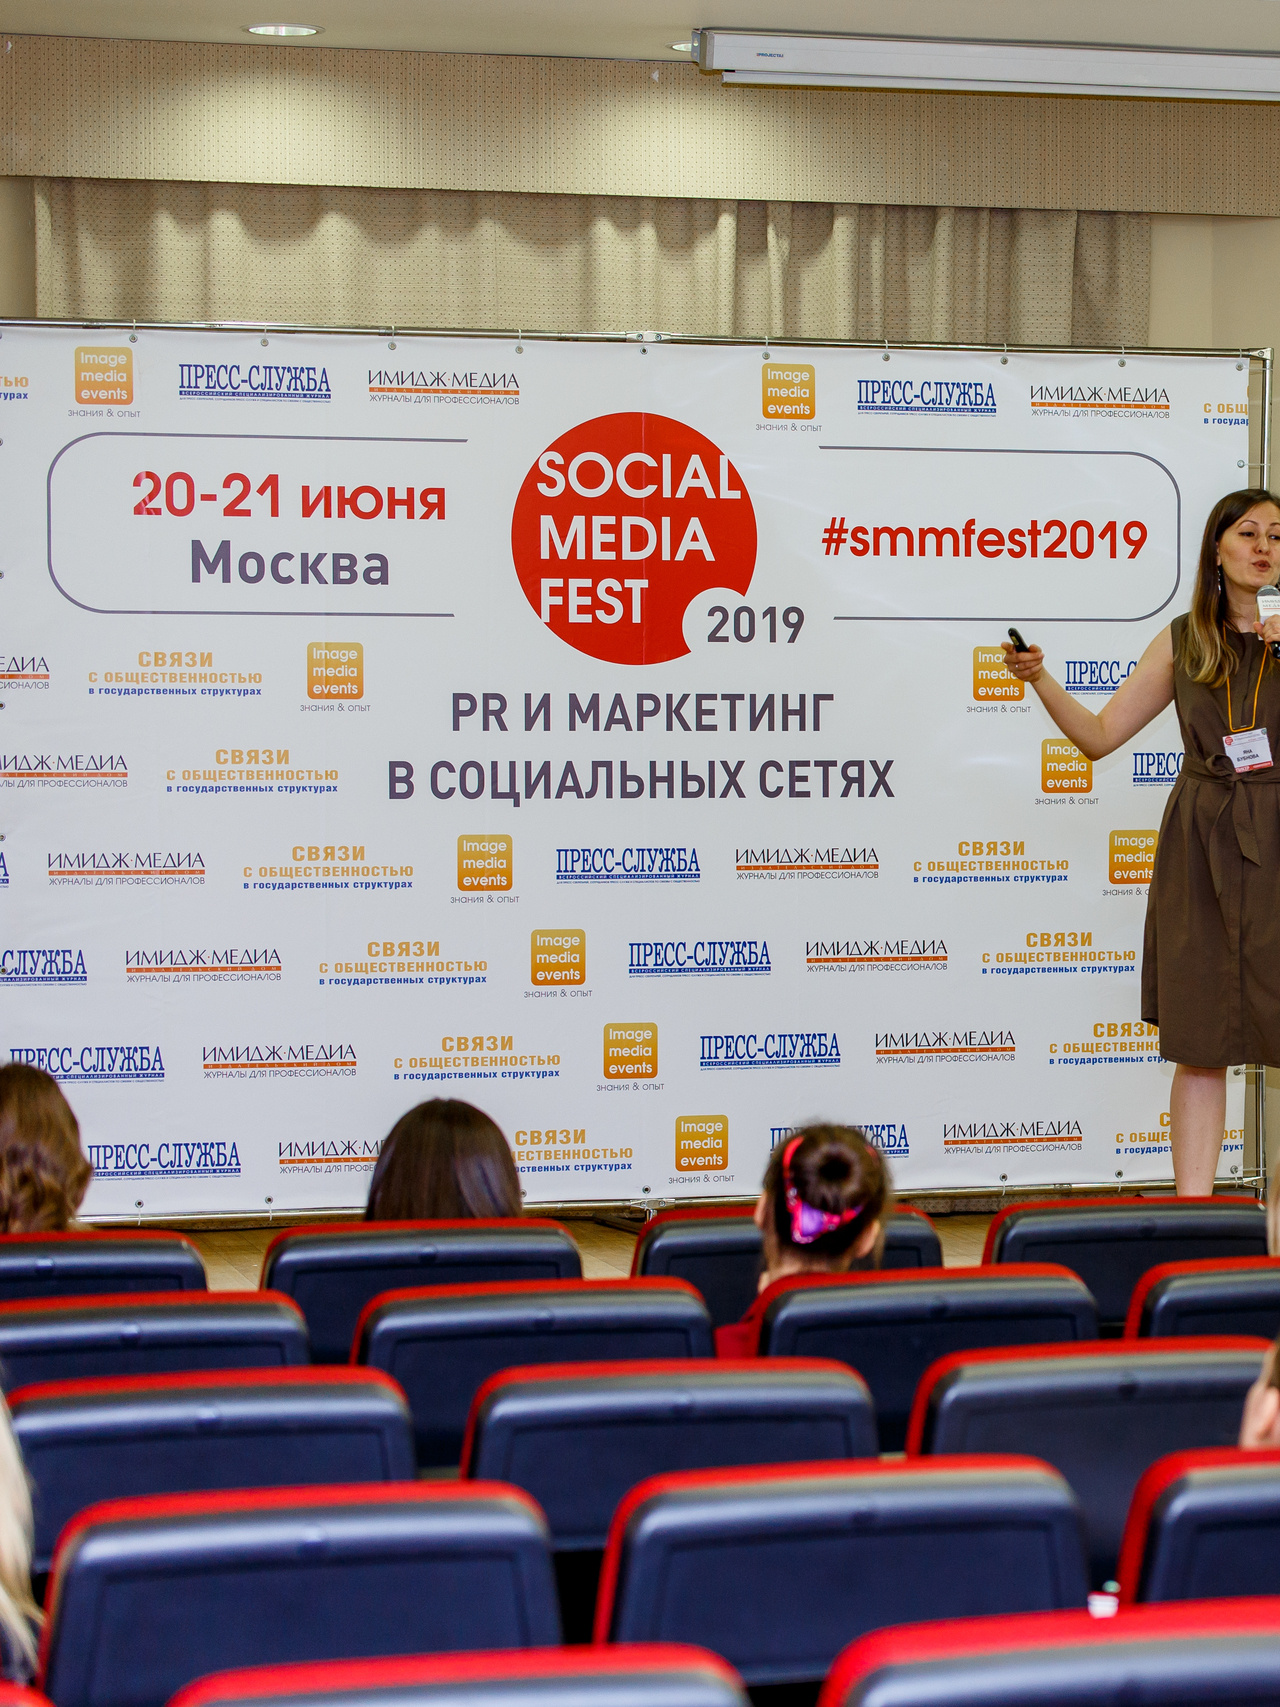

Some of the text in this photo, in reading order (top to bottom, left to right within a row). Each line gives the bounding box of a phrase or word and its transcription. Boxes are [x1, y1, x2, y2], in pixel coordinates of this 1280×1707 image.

[80, 352, 128, 367] Image
[80, 370, 127, 382] media
[179, 364, 331, 392] ПРЕСС-СЛУЖБА
[767, 369, 810, 384] Image
[81, 387, 128, 400] events
[767, 385, 809, 398] media
[858, 378, 996, 407] ПРЕСС-СЛУЖБА
[370, 395, 412, 403] ЖУРНАЛЫ
[434, 397, 519, 405] ПРОФЕССИОНАЛОВ
[68, 408, 141, 418] знания & опыт
[767, 402, 810, 416] events
[1031, 409, 1170, 418] ЖУРНАЛЫ ДЛЯ ПРОФЕССИОНАЛОВ
[755, 423, 822, 433] знания & опыт
[537, 451, 742, 499] SOCIAL
[133, 471, 445, 520] 20-21 июня
[540, 514, 716, 562] MEDIA
[822, 517, 1147, 559] #smmfest2019
[192, 540, 388, 585] Москва
[540, 577, 649, 624] FEST
[708, 606, 804, 643] 2019
[139, 652, 212, 667] СВЯЗИ
[313, 647, 357, 662] Image
[89, 672, 262, 684] С ОБЩЕСТВЕННОСТЬЮ
[313, 665, 356, 678] media
[99, 688, 196, 696] государственных
[313, 682, 358, 695] events
[348, 704, 370, 712] опыт
[453, 693, 834, 732] PR И МАРКЕТИНГ
[216, 749, 289, 765] СВЯЗИ
[167, 770, 338, 782] С ОБЩЕСТВЕННОСТЬЮ
[389, 760, 895, 807] В СОЦИАЛЬНЫХ СЕТЯХ
[292, 846, 364, 861] СВЯЗИ
[464, 840, 506, 855] Image
[959, 841, 1024, 856] СВЯЗИ
[463, 857, 506, 869] media
[556, 848, 700, 873] ПРЕСС-СЛУЖБА
[914, 860, 1068, 873] С ОБЩЕСТВЕННОСТЬЮ
[244, 866, 413, 879] С ОБЩЕСТВЕННОСТЬЮ
[736, 870, 879, 880] ЖУРНАЛЫ ДЛЯ ПРОФЕССИОНАЛОВ
[48, 876, 206, 886] ЖУРНАЛЫ ДЛЯ ПРОФЕССИОНАЛОВ
[254, 882, 349, 890] государственных
[353, 882, 412, 890] структурах
[463, 875, 507, 887] events
[923, 876, 1010, 884] государственных
[1014, 875, 1067, 883] структурах
[450, 895, 520, 904] знания & опыт
[1027, 932, 1092, 947] СВЯЗИ
[629, 940, 771, 966] ПРЕСС-СЛУЖБА
[982, 951, 1135, 964] С ОБЩЕСТВЕННОСТЬЮ
[127, 972, 282, 982] ЖУРНАЛЫ ДЛЯ ПРОФЕССИОНАЛОВ
[991, 967, 1077, 975] государственных
[1081, 966, 1134, 974] структурах
[700, 1033, 840, 1060] ПРЕСС-СЛУЖБА
[876, 1053, 1016, 1065] ЖУРНАЛЫ ДЛЯ ПРОФЕССИОНАЛОВ
[681, 1121, 723, 1136] Image
[680, 1137, 723, 1150] media
[680, 1154, 723, 1168] events
